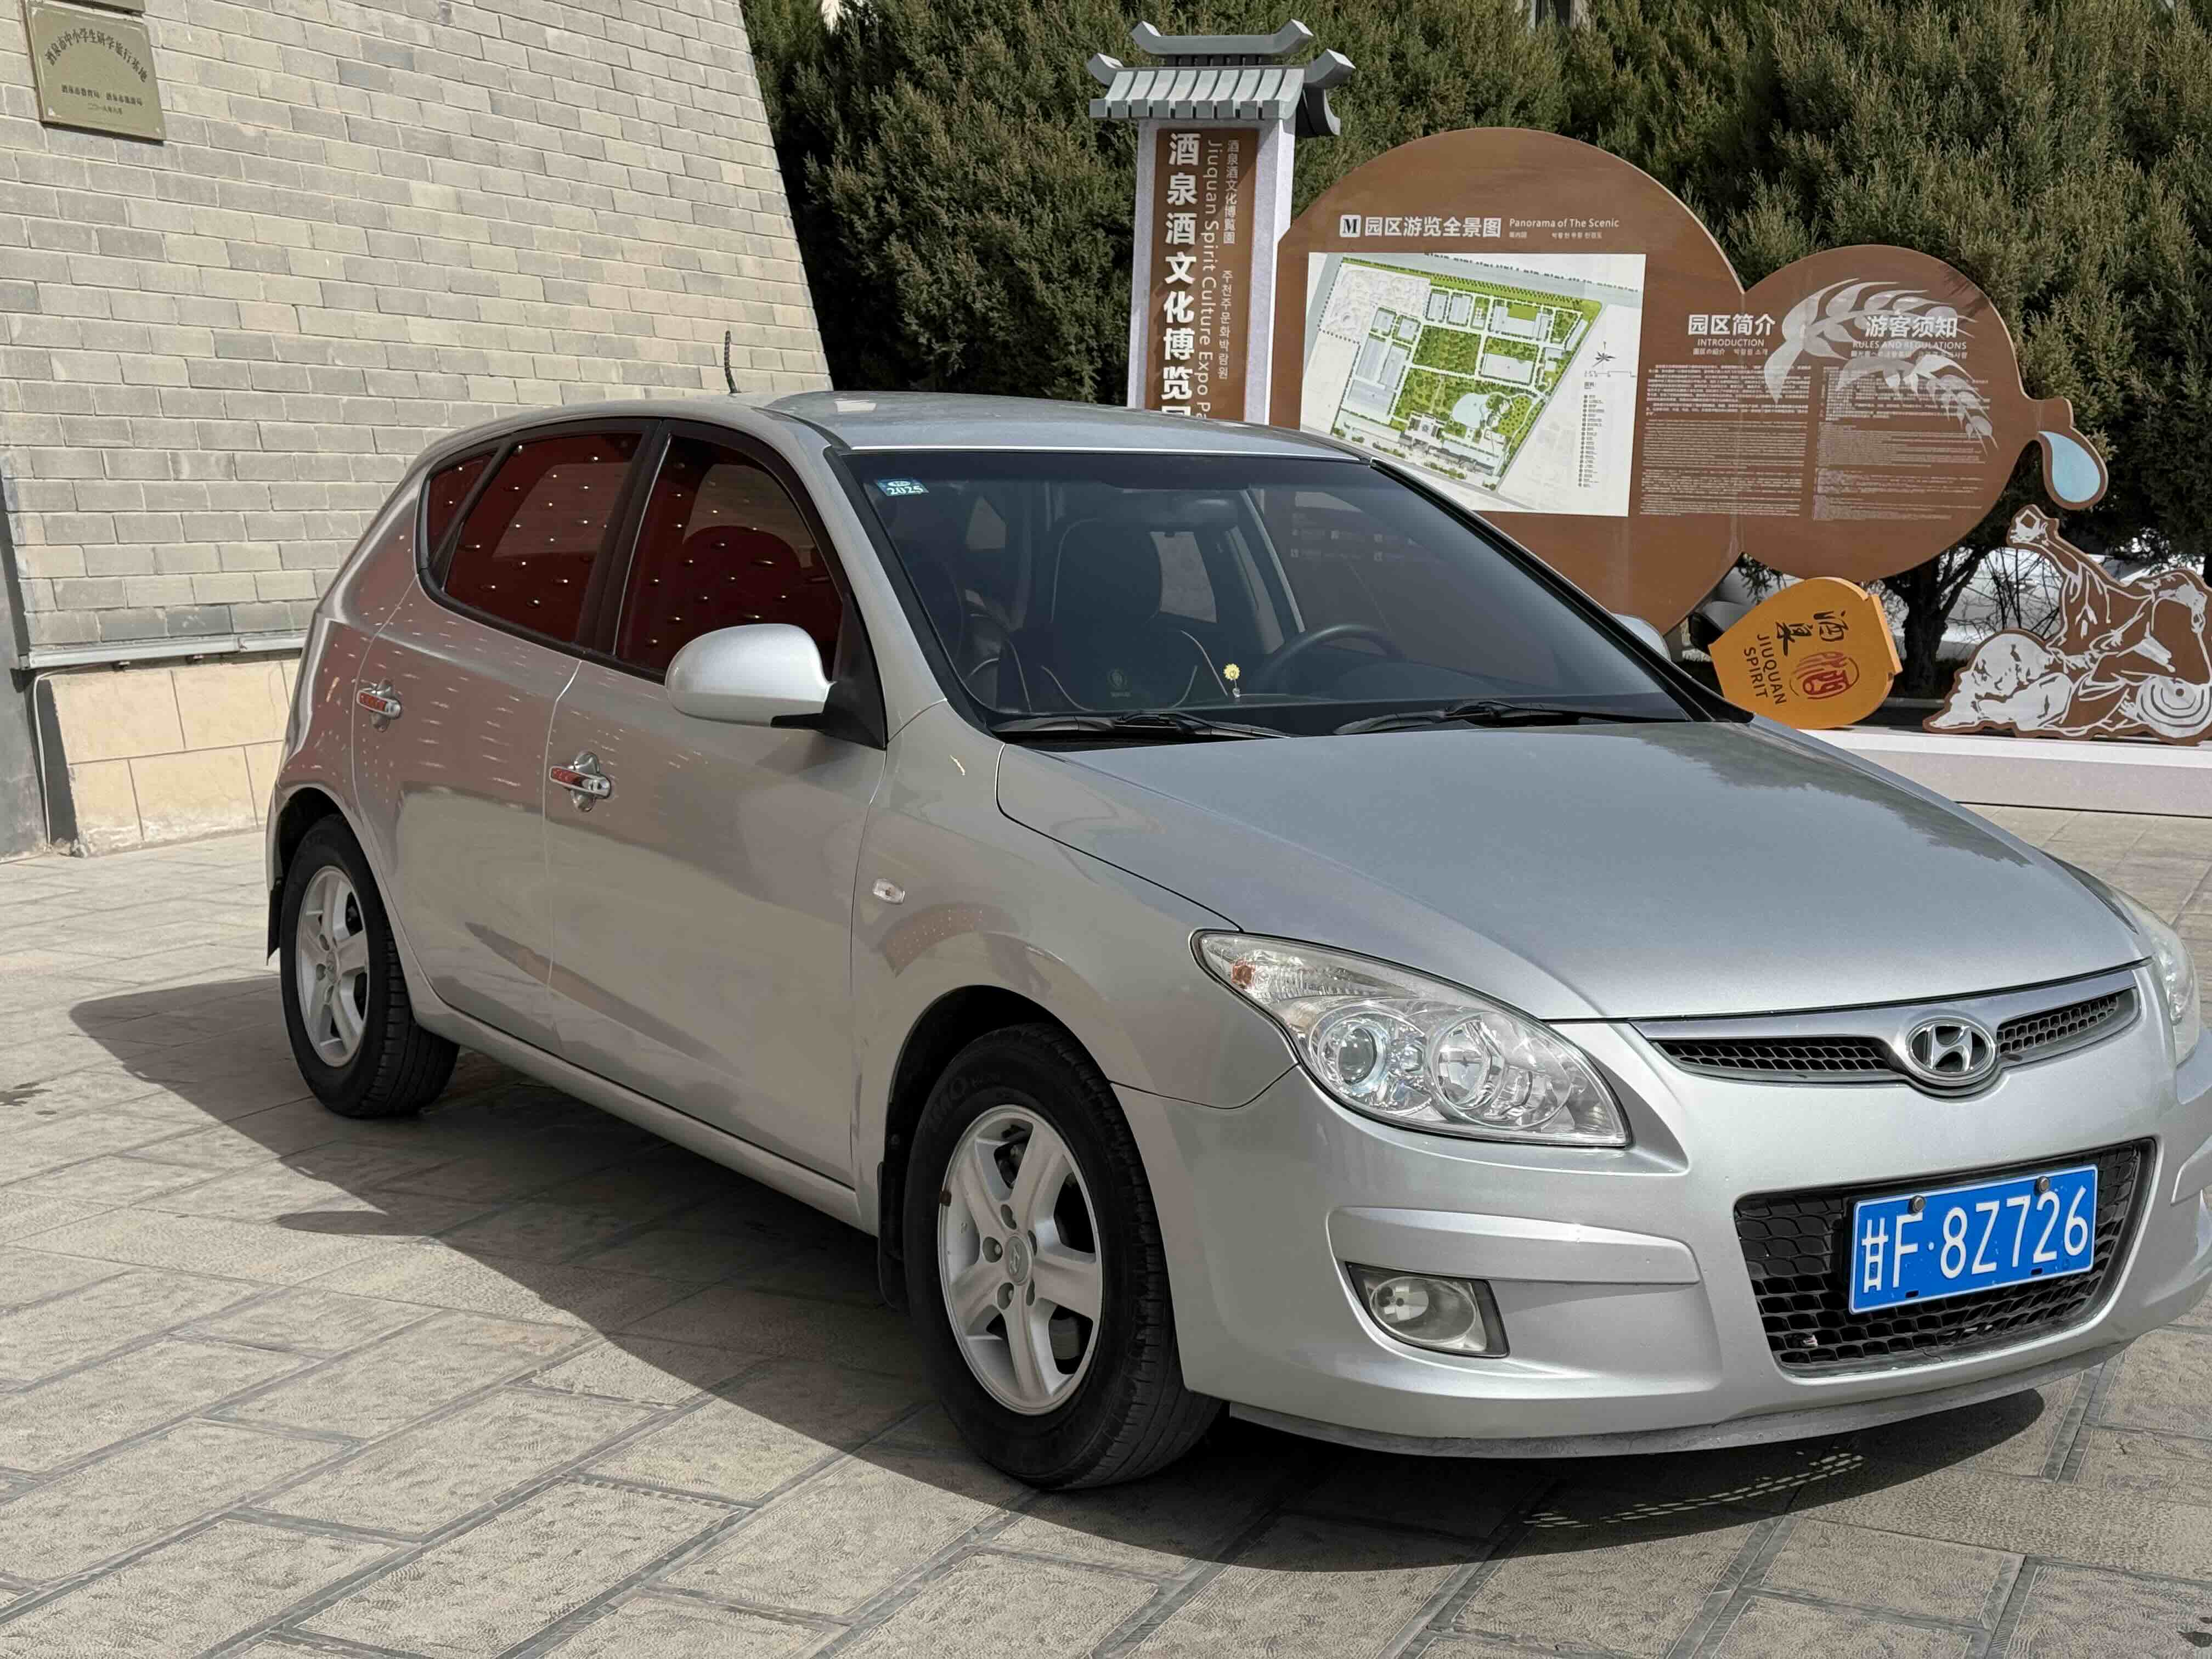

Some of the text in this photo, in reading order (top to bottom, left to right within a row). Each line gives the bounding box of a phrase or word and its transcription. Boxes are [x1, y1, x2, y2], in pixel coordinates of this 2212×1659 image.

[1203, 139, 1222, 215] Jiuquan
[1342, 217, 1359, 236] M
[1364, 216, 1502, 238] 园区游览全景图
[1509, 218, 1620, 229] Panorama of The Scenic
[1200, 220, 1219, 272] Spirit
[1199, 276, 1217, 346] Culture
[1688, 313, 1776, 336] 园区简介
[1865, 314, 1959, 338] 游客须知
[1696, 338, 1765, 347] INTRODUCTION
[1852, 340, 1880, 350] RULES
[1881, 340, 1903, 350] AND
[1194, 352, 1214, 395] Expo
[886, 485, 923, 495] 2025
[1743, 646, 1768, 698] SPIRIT
[1757, 634, 1787, 706] JIUQUAN
